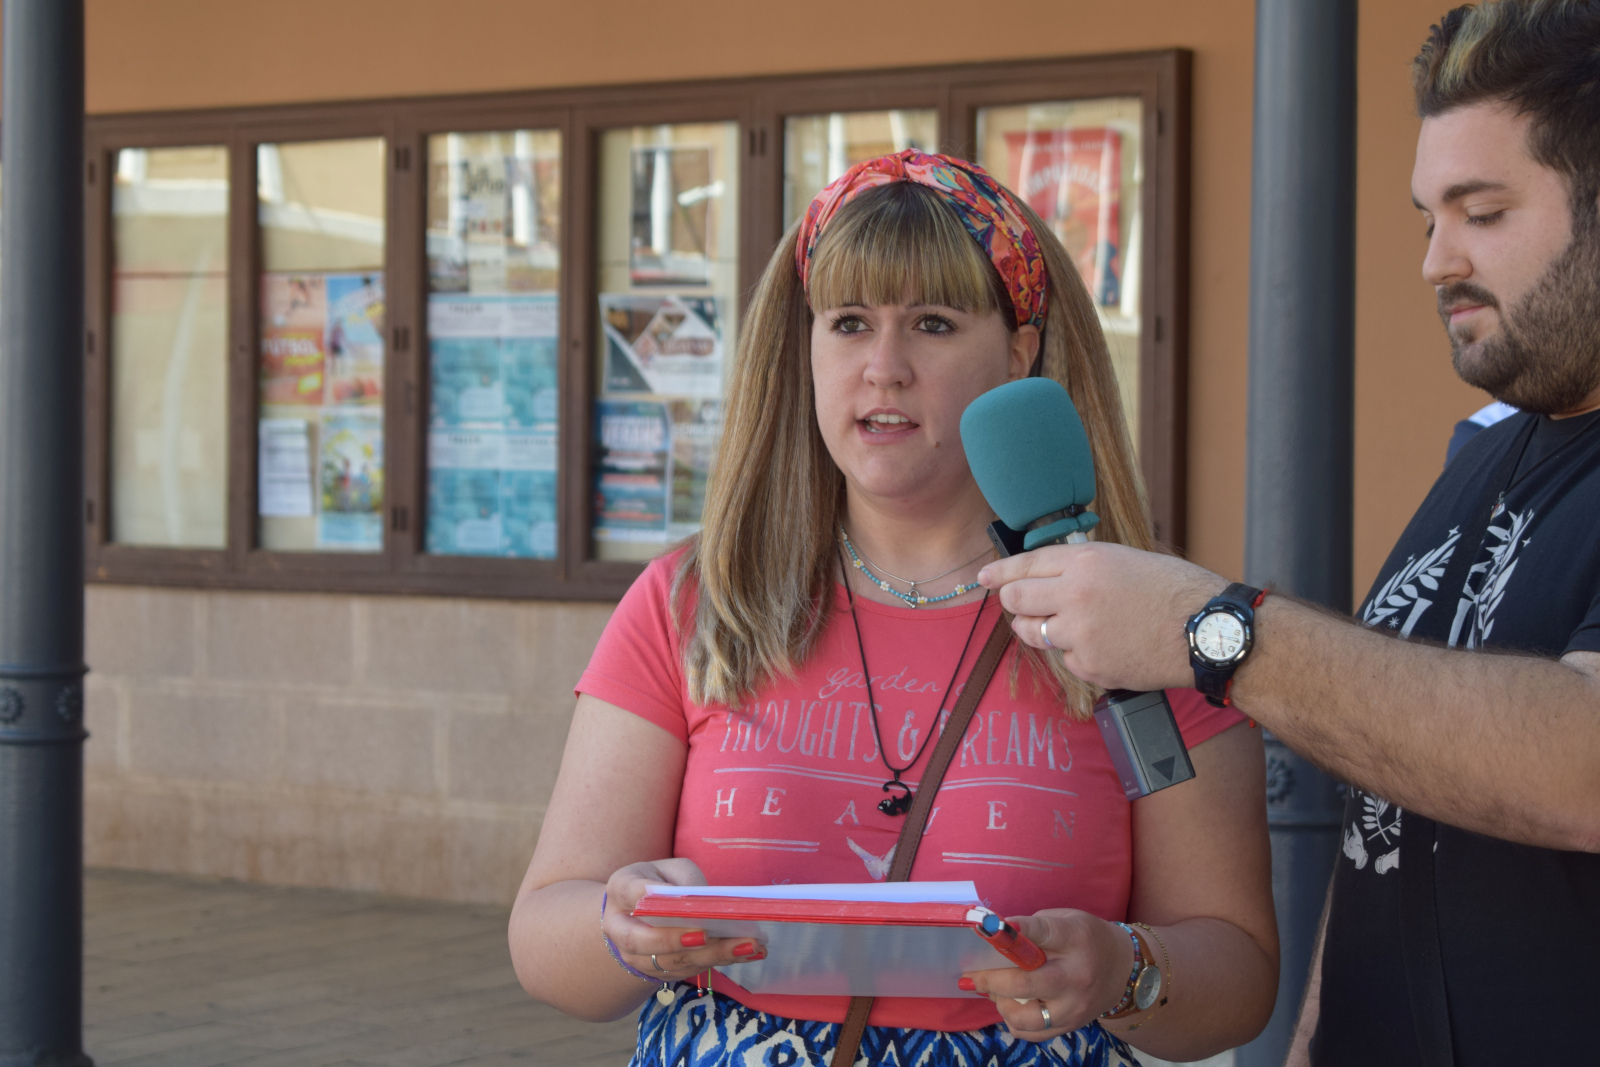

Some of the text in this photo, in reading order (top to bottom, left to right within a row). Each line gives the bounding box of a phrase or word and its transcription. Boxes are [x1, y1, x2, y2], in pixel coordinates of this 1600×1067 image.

[819, 665, 941, 699] garden
[719, 699, 883, 763] THOUGHTS
[897, 709, 920, 761] &
